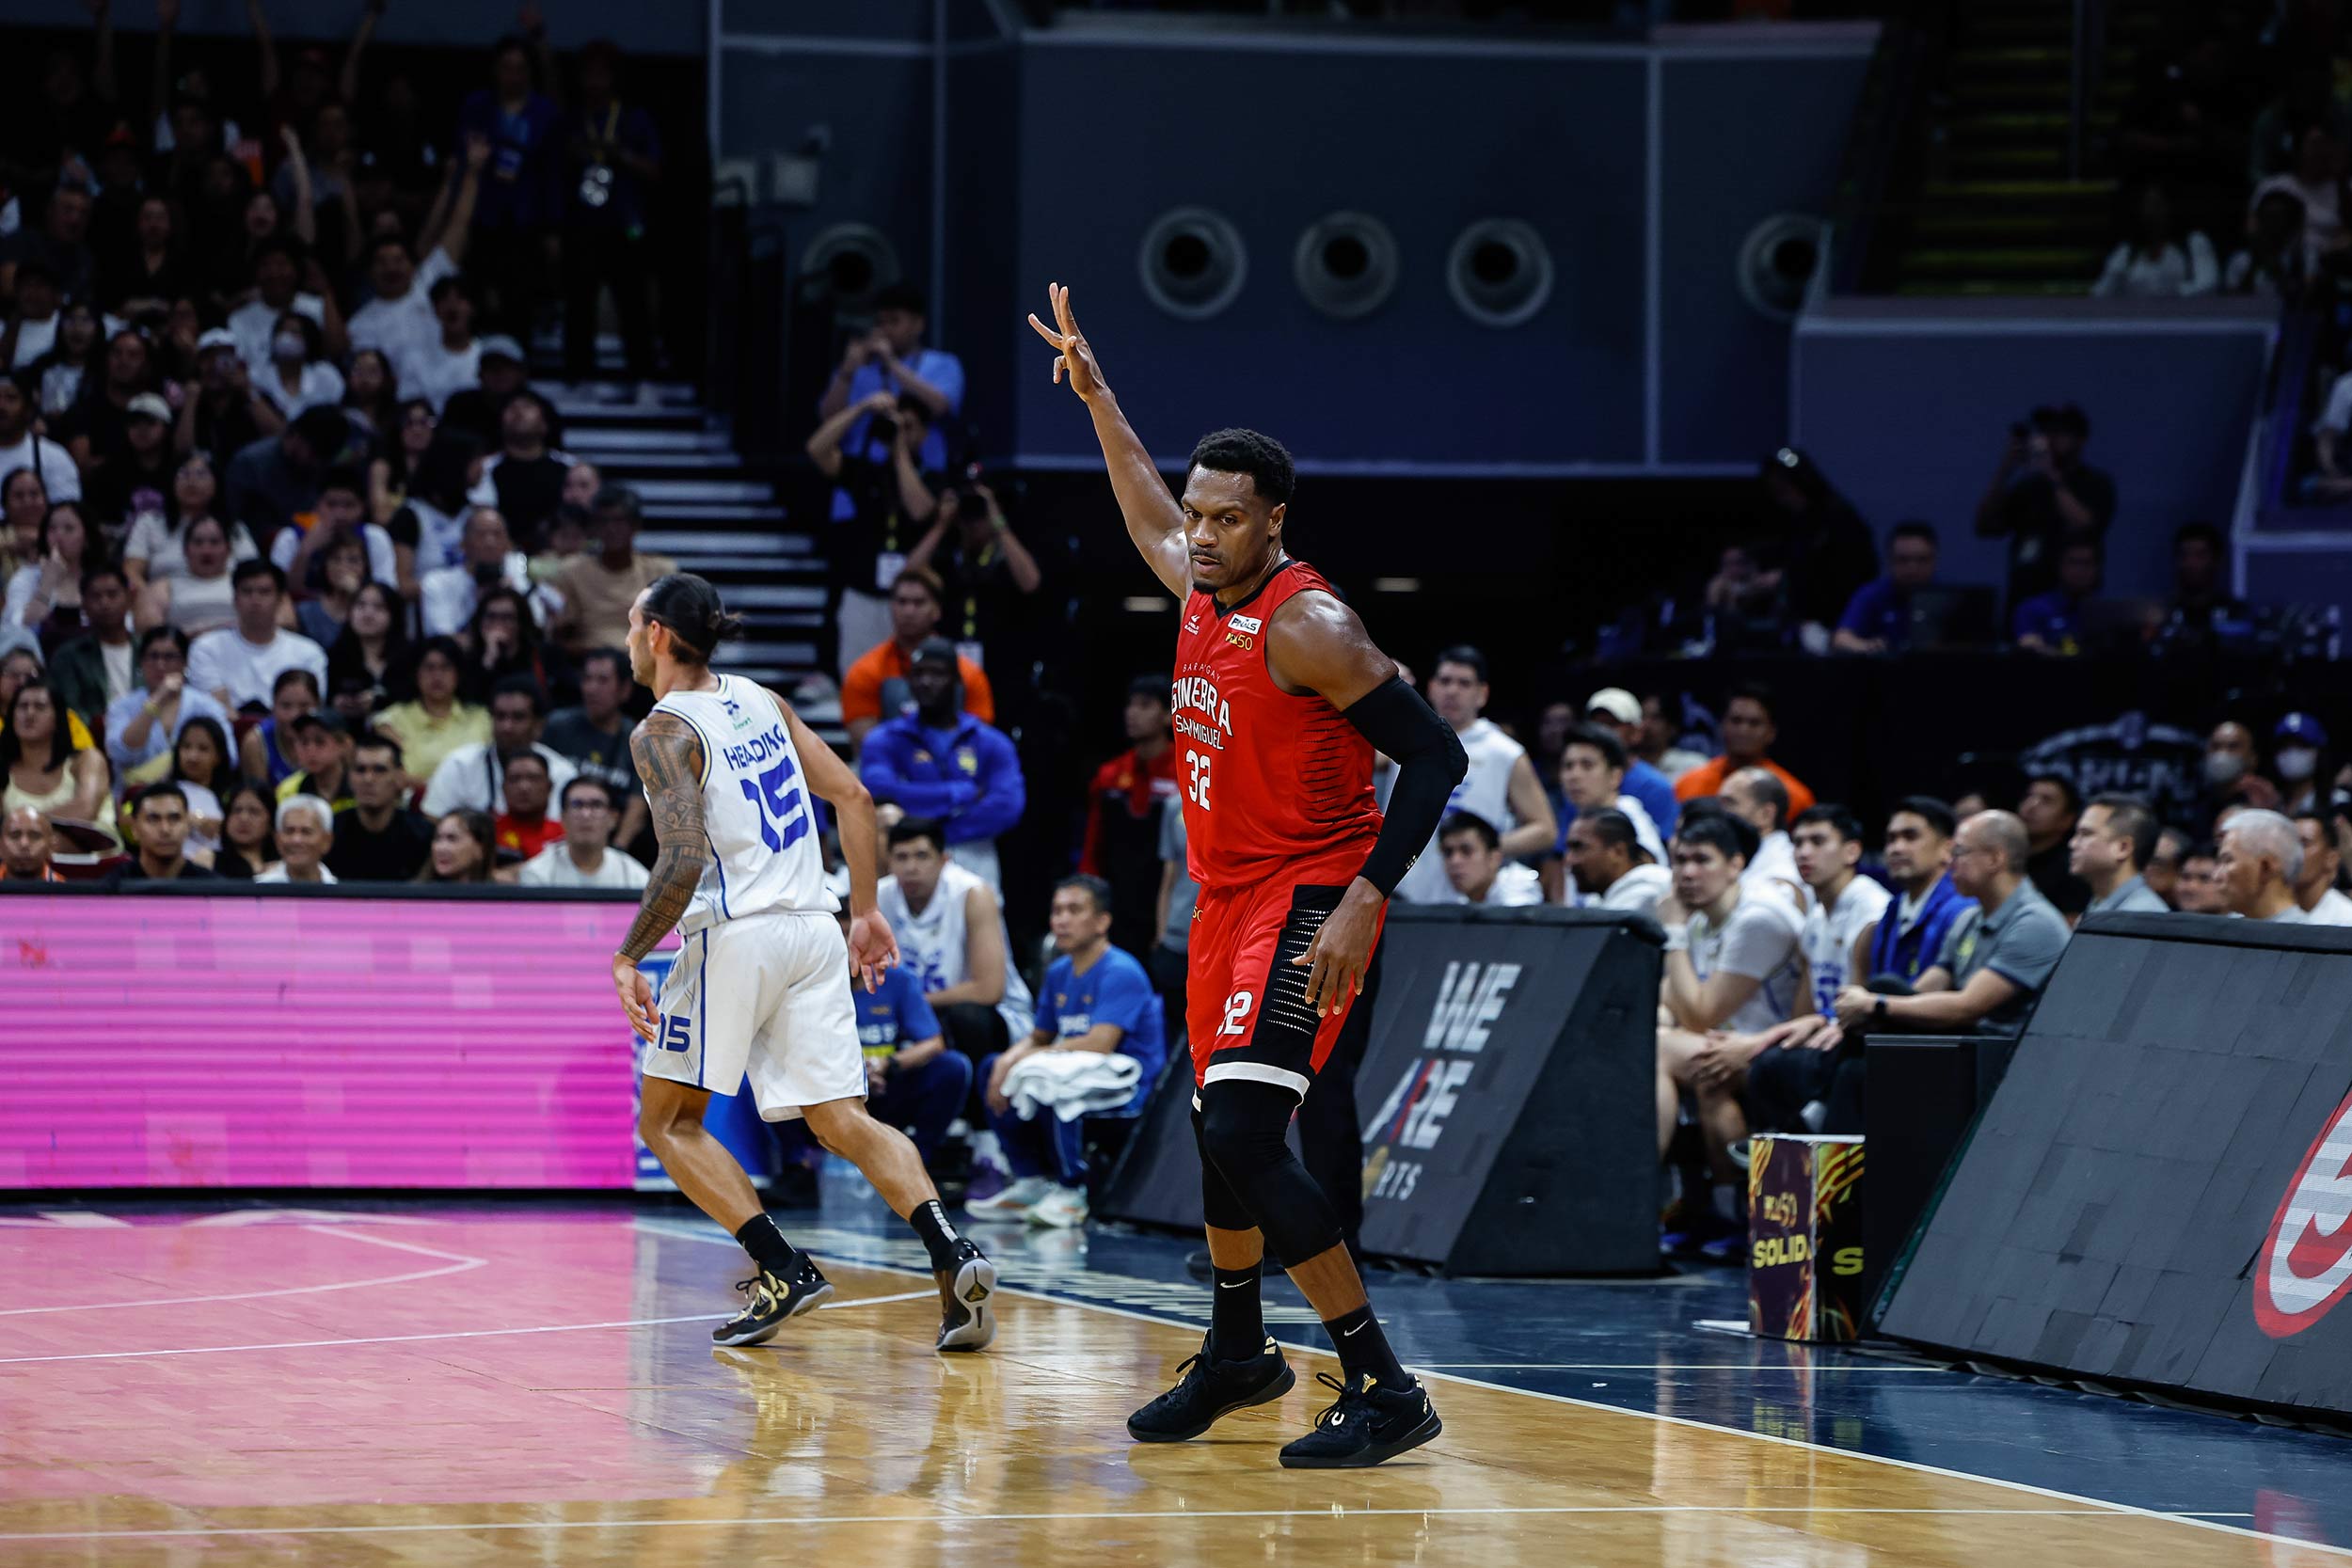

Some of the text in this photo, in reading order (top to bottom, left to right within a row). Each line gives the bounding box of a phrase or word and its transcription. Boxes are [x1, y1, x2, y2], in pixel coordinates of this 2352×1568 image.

[1182, 661, 1221, 683] BARAGAY
[1171, 676, 1233, 736] GINEBRA
[723, 723, 787, 771] HEADING
[1193, 721, 1224, 750] MIGUEL
[739, 756, 809, 854] 15
[1185, 749, 1212, 813] 32
[1422, 960, 1522, 1053] WE
[658, 1012, 691, 1053] 15
[1753, 1233, 1807, 1269] SOLID
